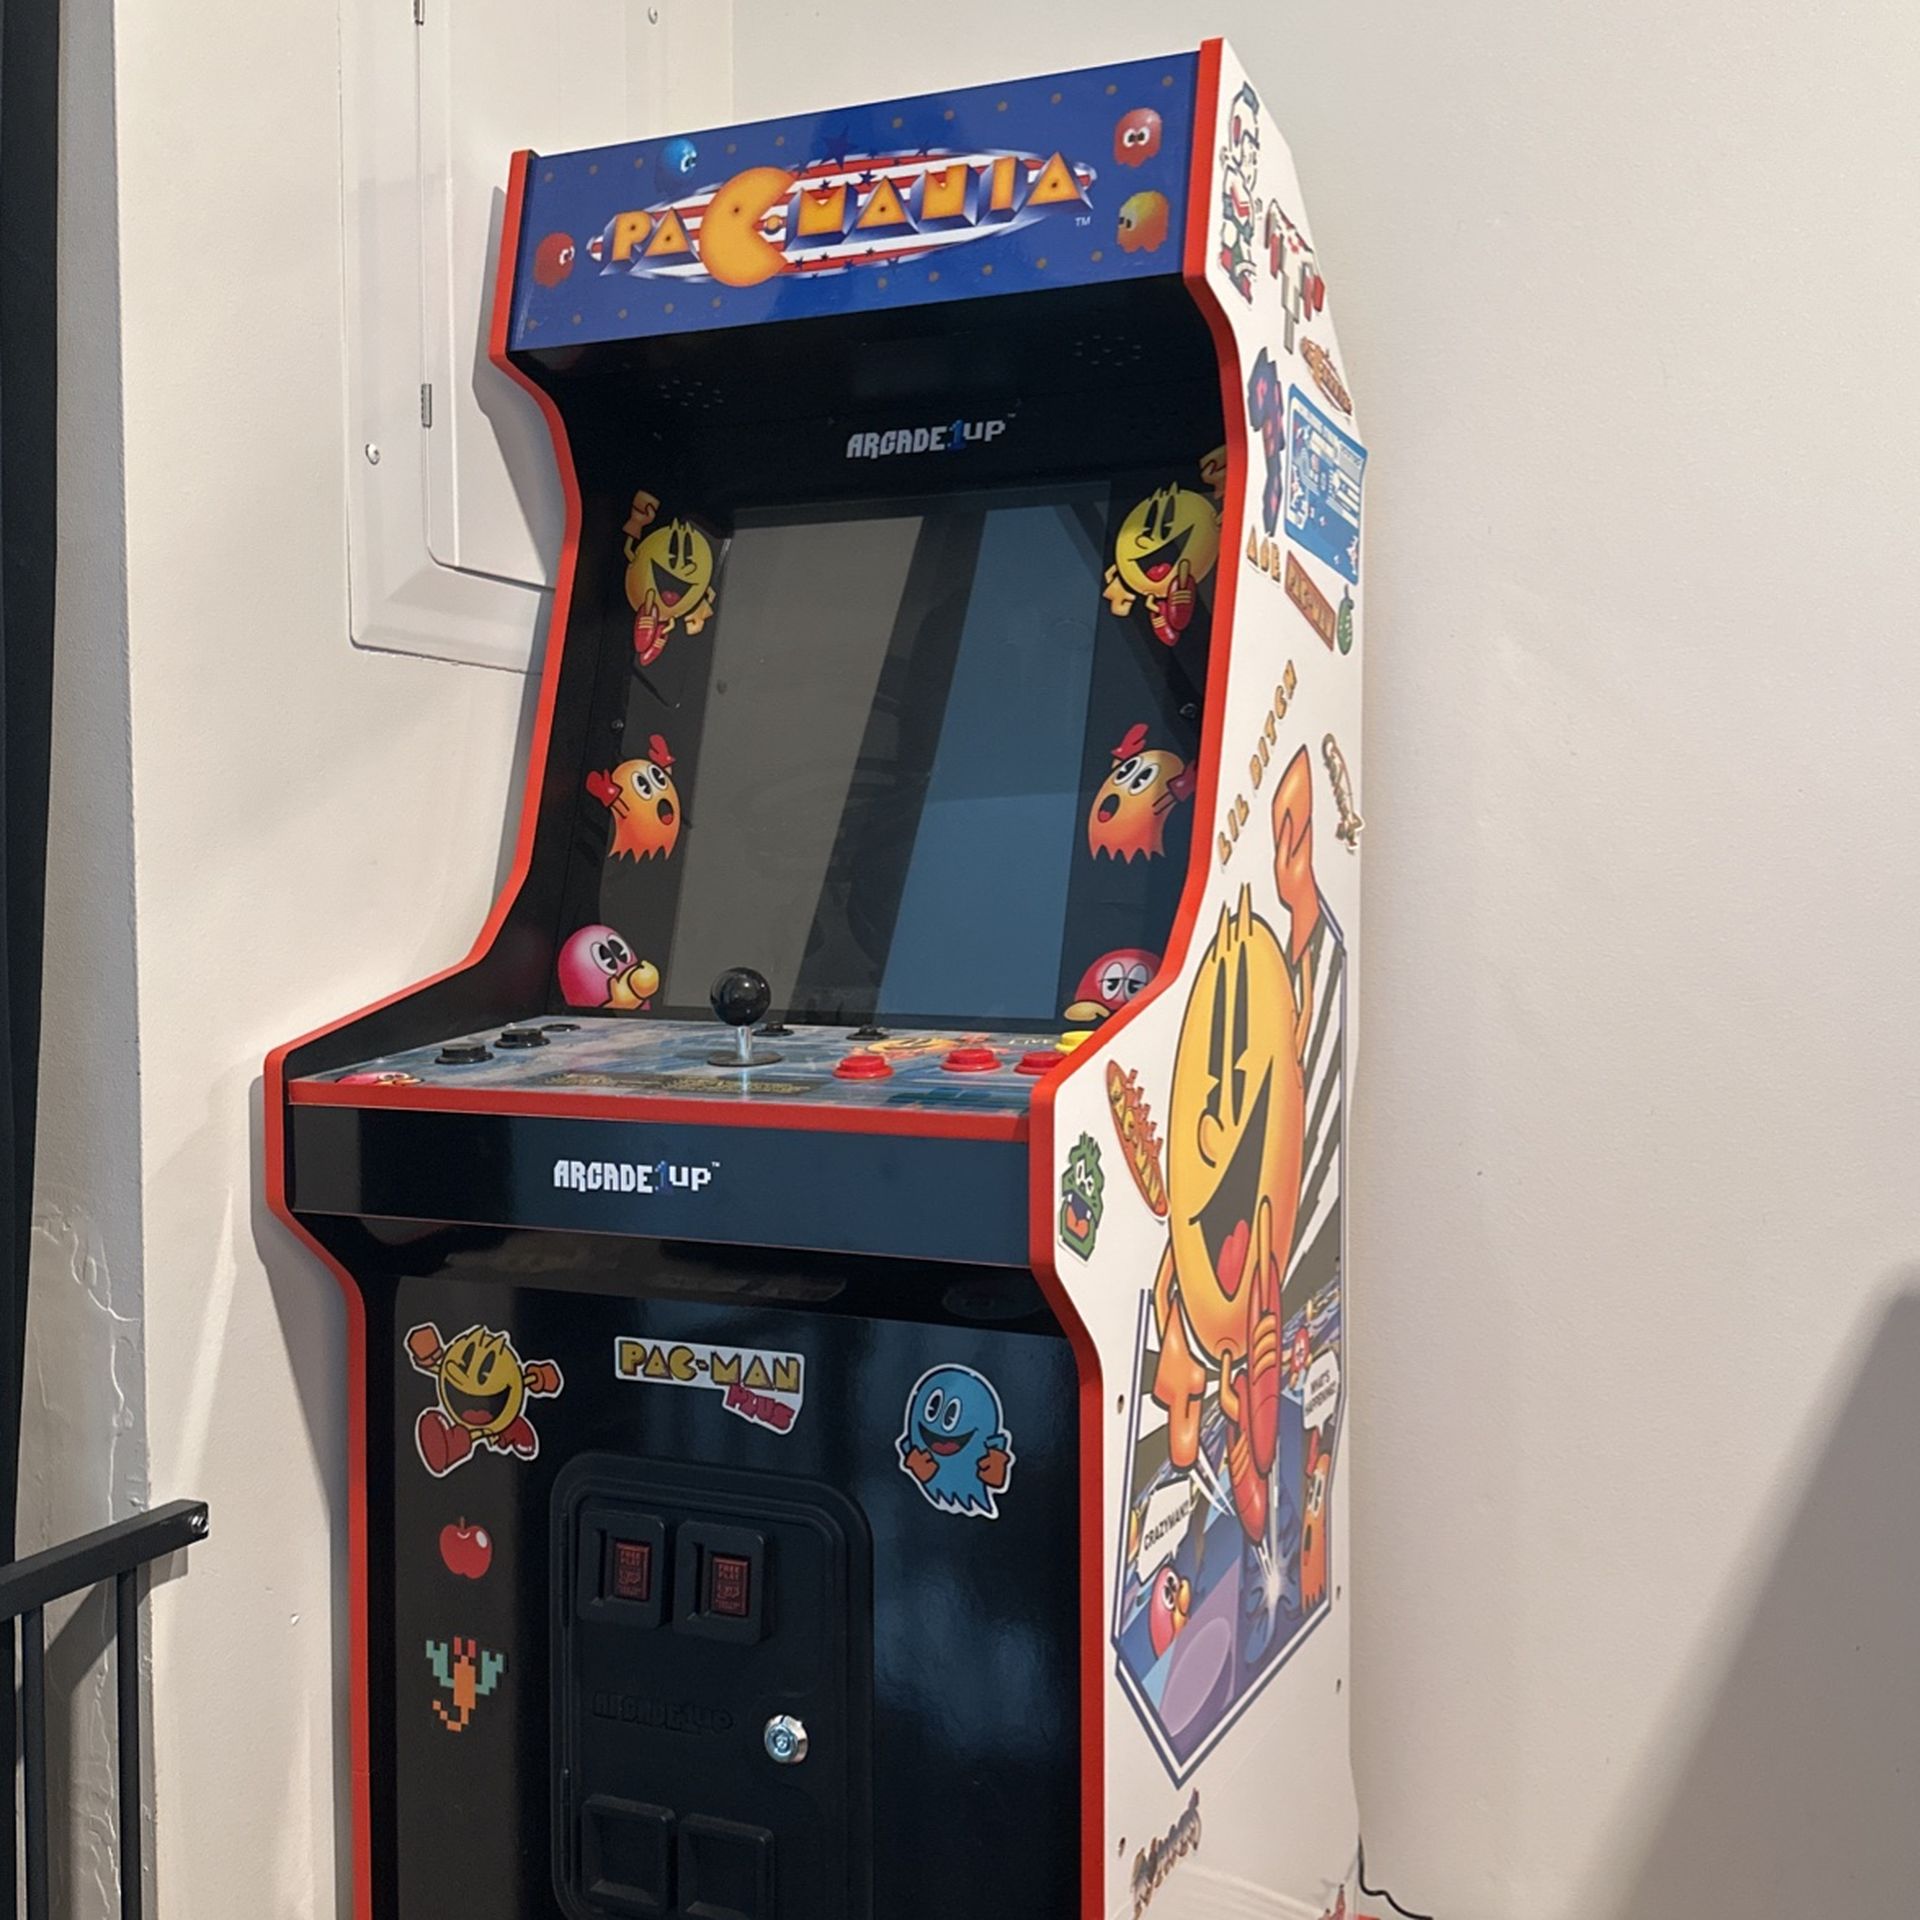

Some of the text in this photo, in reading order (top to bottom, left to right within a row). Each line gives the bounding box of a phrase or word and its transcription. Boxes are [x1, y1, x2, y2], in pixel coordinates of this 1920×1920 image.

[846, 418, 1007, 460] ARCADE1UP
[553, 1159, 712, 1195] ARCADE1UP
[619, 1340, 801, 1394] PAC-MAN
[726, 1382, 796, 1431] PLUS
